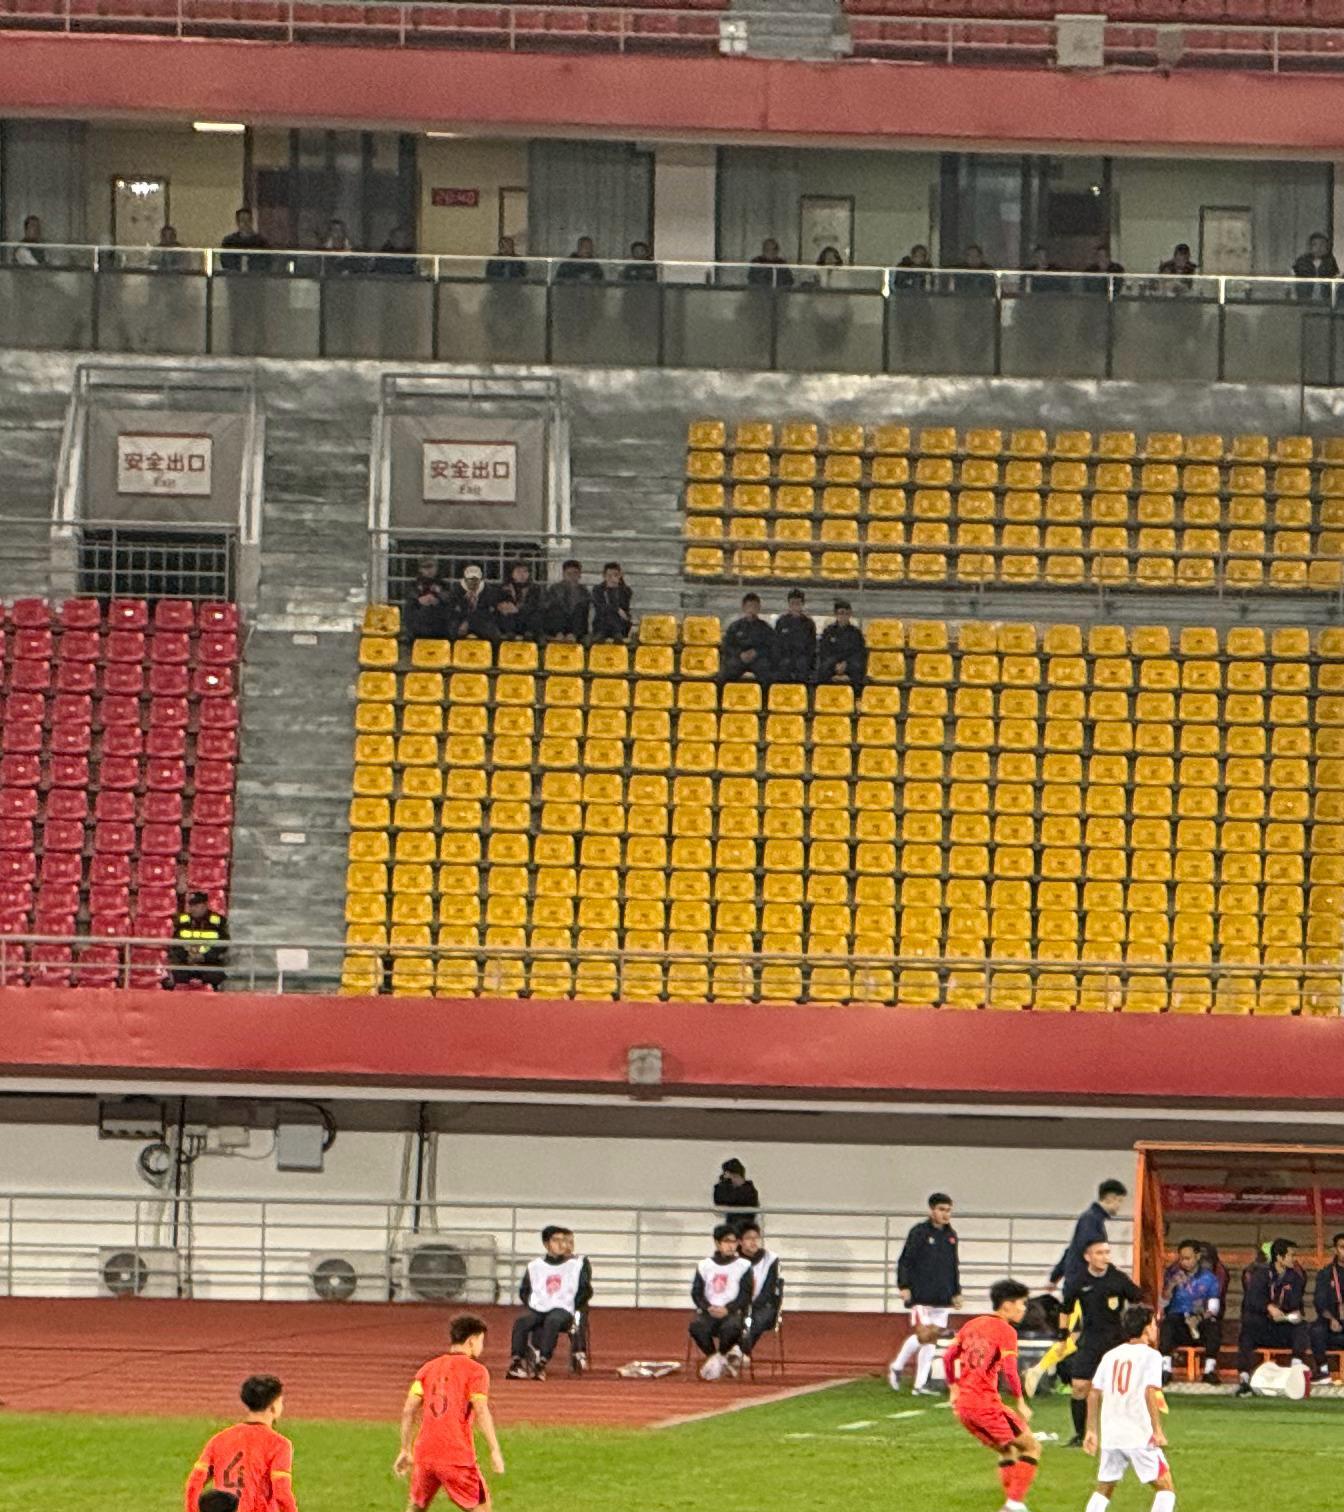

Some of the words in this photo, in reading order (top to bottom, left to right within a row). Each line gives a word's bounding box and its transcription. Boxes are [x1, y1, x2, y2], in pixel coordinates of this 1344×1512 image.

[124, 453, 205, 473] 安全出口
[430, 459, 510, 479] 安全出口
[1111, 1359, 1133, 1396] 10
